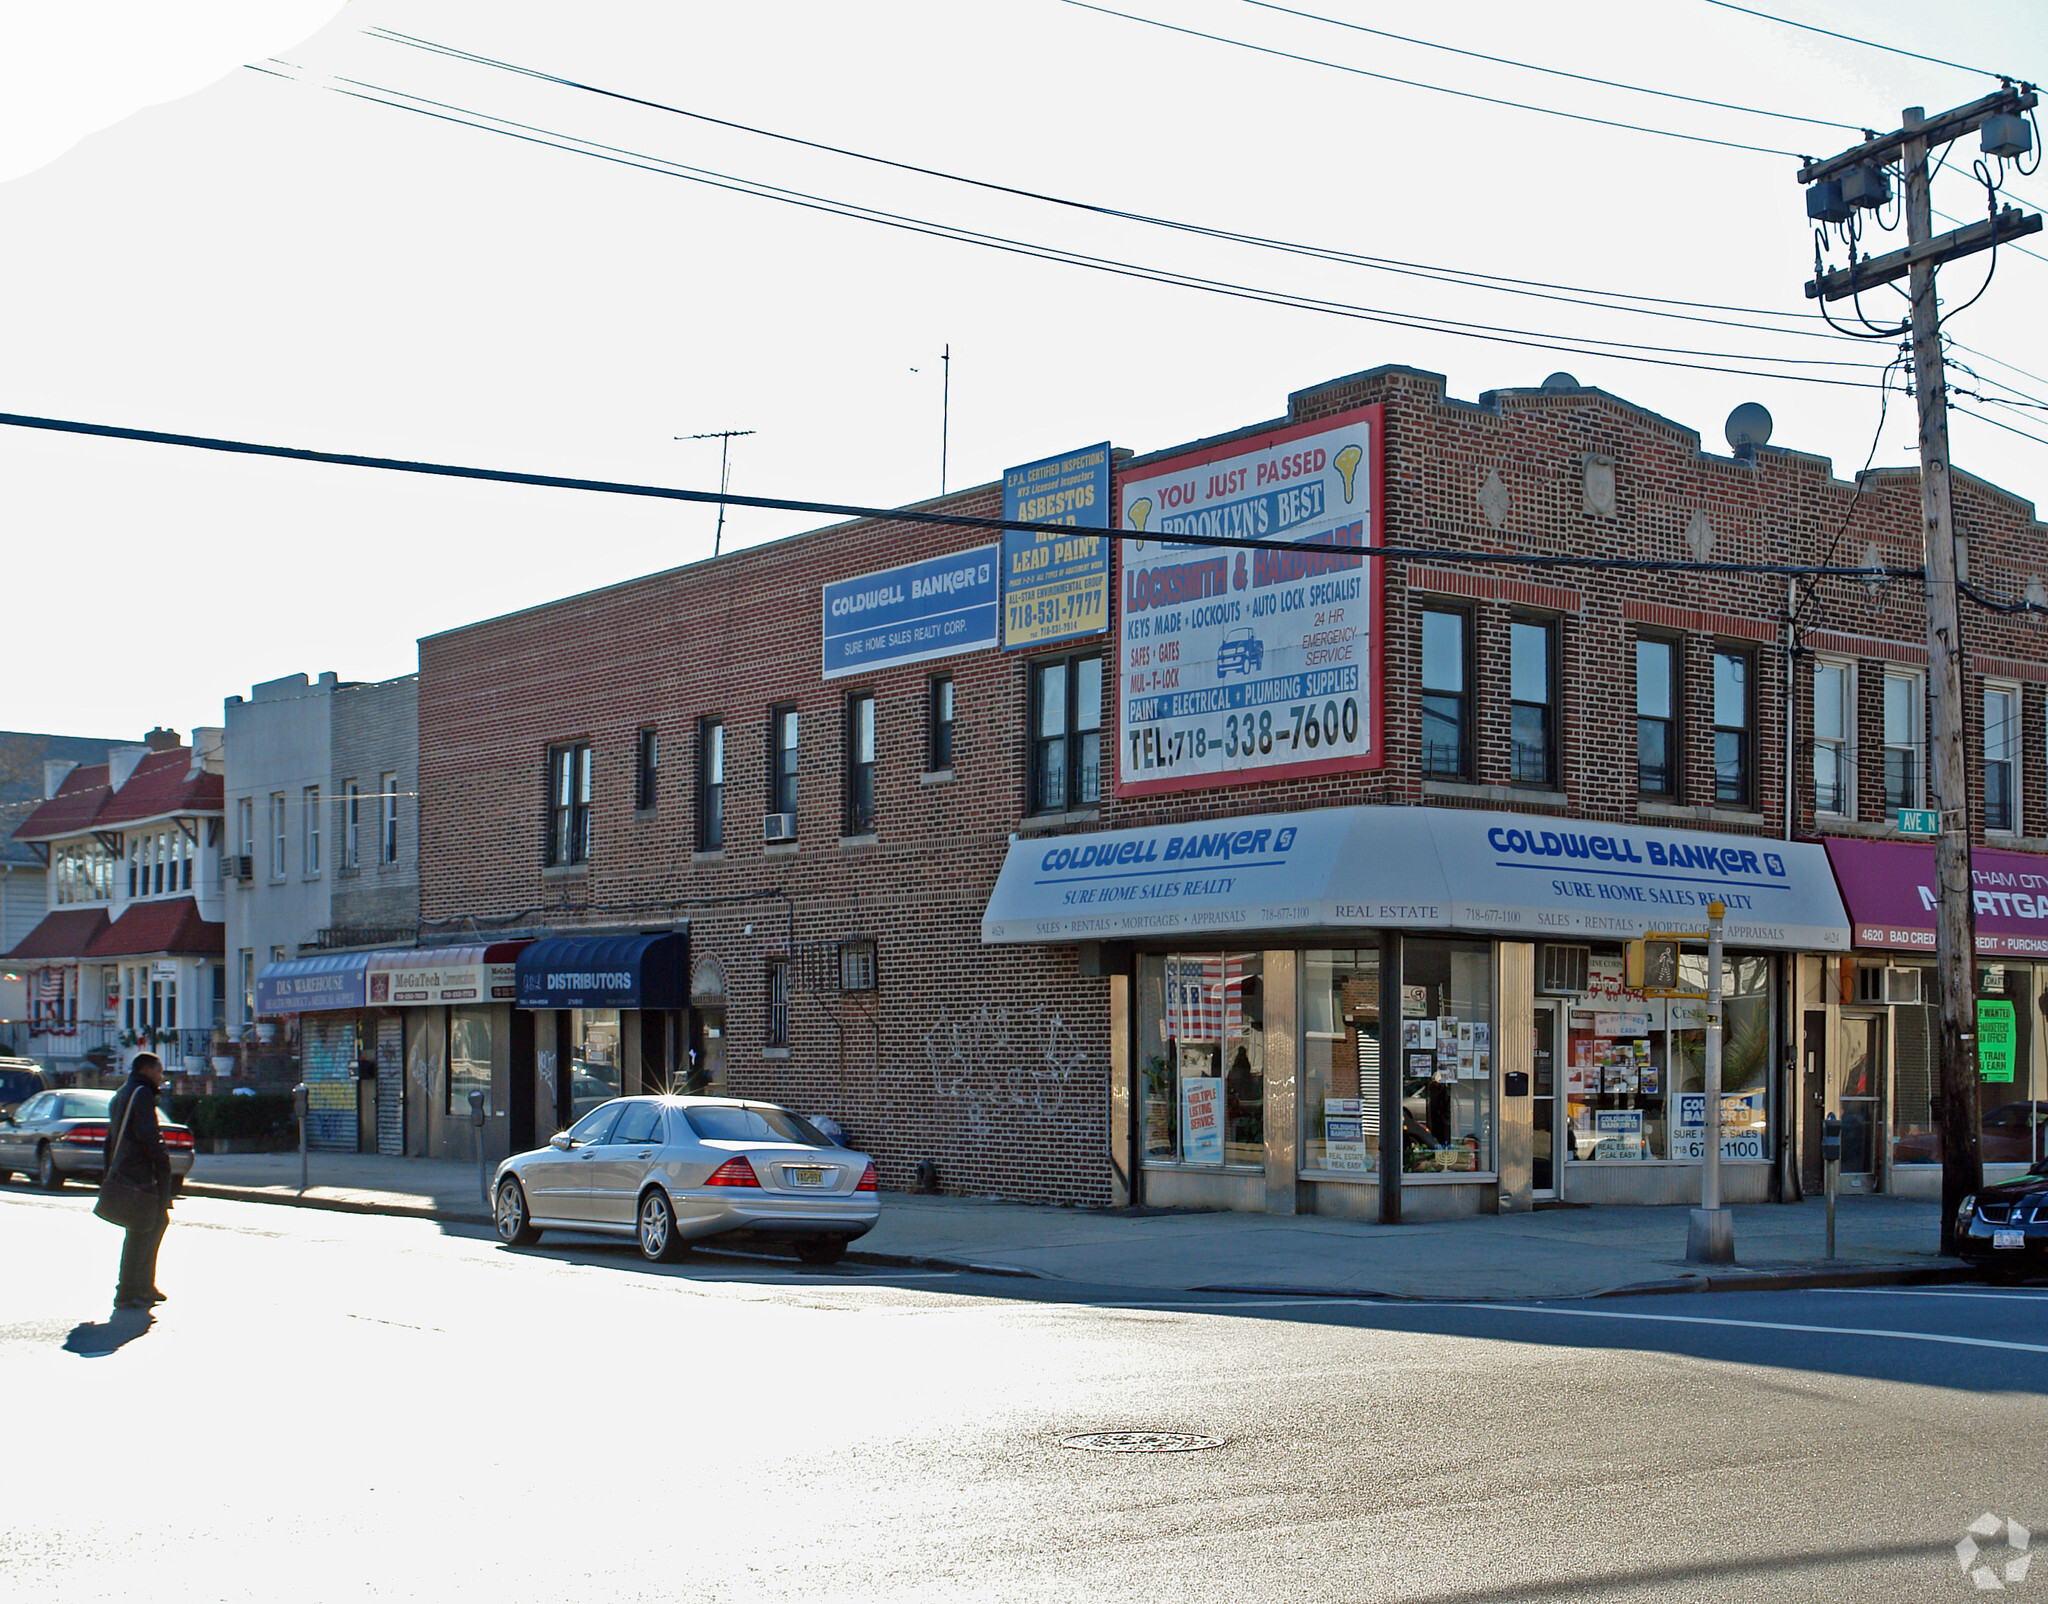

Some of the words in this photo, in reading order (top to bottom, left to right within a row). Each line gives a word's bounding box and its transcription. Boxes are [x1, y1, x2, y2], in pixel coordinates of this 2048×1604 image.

[1028, 463, 1059, 482] CERTIFIED
[1062, 450, 1104, 473] INSPECTIONS
[1157, 481, 1195, 509] YOU
[1205, 468, 1247, 500] JUST
[1257, 448, 1326, 486] PASSED
[1032, 478, 1059, 494] Licensed
[1060, 470, 1094, 487] Inspectors
[1018, 484, 1094, 522] ASBESTOS
[1162, 498, 1268, 549] BROOKLYN'S
[1278, 483, 1323, 527] BEST
[1013, 546, 1049, 574] LEAD
[1055, 536, 1099, 564] PAINT
[1127, 556, 1227, 613] LOCKSMITH
[1233, 551, 1248, 592] &
[1253, 520, 1363, 588] HARDWARE
[832, 585, 904, 616] COLDWELL
[912, 567, 976, 599] BANKER
[1009, 590, 1035, 604] ALL-STAR
[1037, 581, 1082, 598] ENVIRONMENTAL
[1084, 576, 1103, 588] GROUP
[1010, 590, 1101, 630] 718-531-7777
[1128, 616, 1150, 640] KEYS
[1154, 612, 1182, 635] MADE
[1192, 600, 1240, 628] LOCKOUTS
[1252, 596, 1276, 619] AUTO
[1281, 587, 1305, 612] LOCK
[1310, 577, 1361, 607] SPECIALIST
[1314, 611, 1325, 627] 24
[1328, 608, 1344, 623] HR
[844, 640, 862, 656] SURE
[866, 637, 886, 651] HOME
[888, 630, 912, 646] SALES
[914, 624, 940, 641] REALTY
[944, 619, 967, 636] CORP.
[1302, 626, 1357, 650] EMERGENCY
[1131, 646, 1150, 668] SAFES
[1159, 640, 1180, 663] GATES
[1306, 645, 1353, 666] SERVICE
[1130, 698, 1159, 722] PAINT
[1172, 688, 1230, 716] ELECTRICAL
[1245, 677, 1300, 706] PLUMBING
[1306, 666, 1357, 696] SUPPLIES
[1904, 812, 1922, 831] AVE
[1928, 814, 1935, 831] N
[1041, 839, 1158, 872] COLDWELL
[1163, 828, 1272, 861] BANKER
[1487, 828, 1642, 863] COLDWELL
[1646, 841, 1758, 876] BANKER
[1972, 870, 2017, 887] THAM
[1063, 890, 1096, 905] SURE
[1099, 886, 1139, 902] HOME
[1139, 882, 1179, 899] SALES
[1184, 878, 1236, 895] REALTY
[1552, 881, 1596, 898] SURE
[1599, 883, 1646, 902] HOME
[1649, 888, 1695, 906] SALES
[991, 926, 1004, 936] 4624
[1036, 922, 1060, 934] SALES
[1071, 919, 1110, 932] RENTALS
[1121, 914, 1179, 929] MORTGAGES
[1191, 910, 1246, 925] APPRAISALS
[1261, 908, 1309, 921] 718-677-1100
[1336, 906, 1374, 918] REAL
[1380, 906, 1438, 919] ESTATE
[1466, 908, 1520, 923] 718-677-1100
[1537, 912, 1570, 927] SALES
[1585, 916, 1634, 931] RENTALS
[1648, 921, 1708, 933] MORTGAGE
[1728, 926, 1784, 940] APPRAISALS
[1824, 932, 1840, 943] 4624
[1862, 930, 1883, 941] 4620
[1890, 931, 1909, 943] BAD
[1910, 932, 1936, 944] CRED
[1975, 937, 1998, 949] REDIT
[276, 980, 291, 995] DLS
[294, 975, 344, 993] WAREHOUSE
[547, 972, 631, 989] DISTRIBUTORS
[1984, 1008, 2010, 1018] WANTED
[1984, 1051, 2006, 1061] TRAIN
[1987, 1062, 2006, 1070] EARN
[1188, 1088, 1216, 1105] MULTIPLE
[1189, 1102, 1212, 1118] LISTING
[1191, 1114, 1214, 1130] SERVICE
[1674, 1130, 1696, 1138] SURE
[1730, 1130, 1758, 1138] SALES
[1674, 1146, 1687, 1154] 718
[1690, 1142, 1758, 1157] 67-1100
